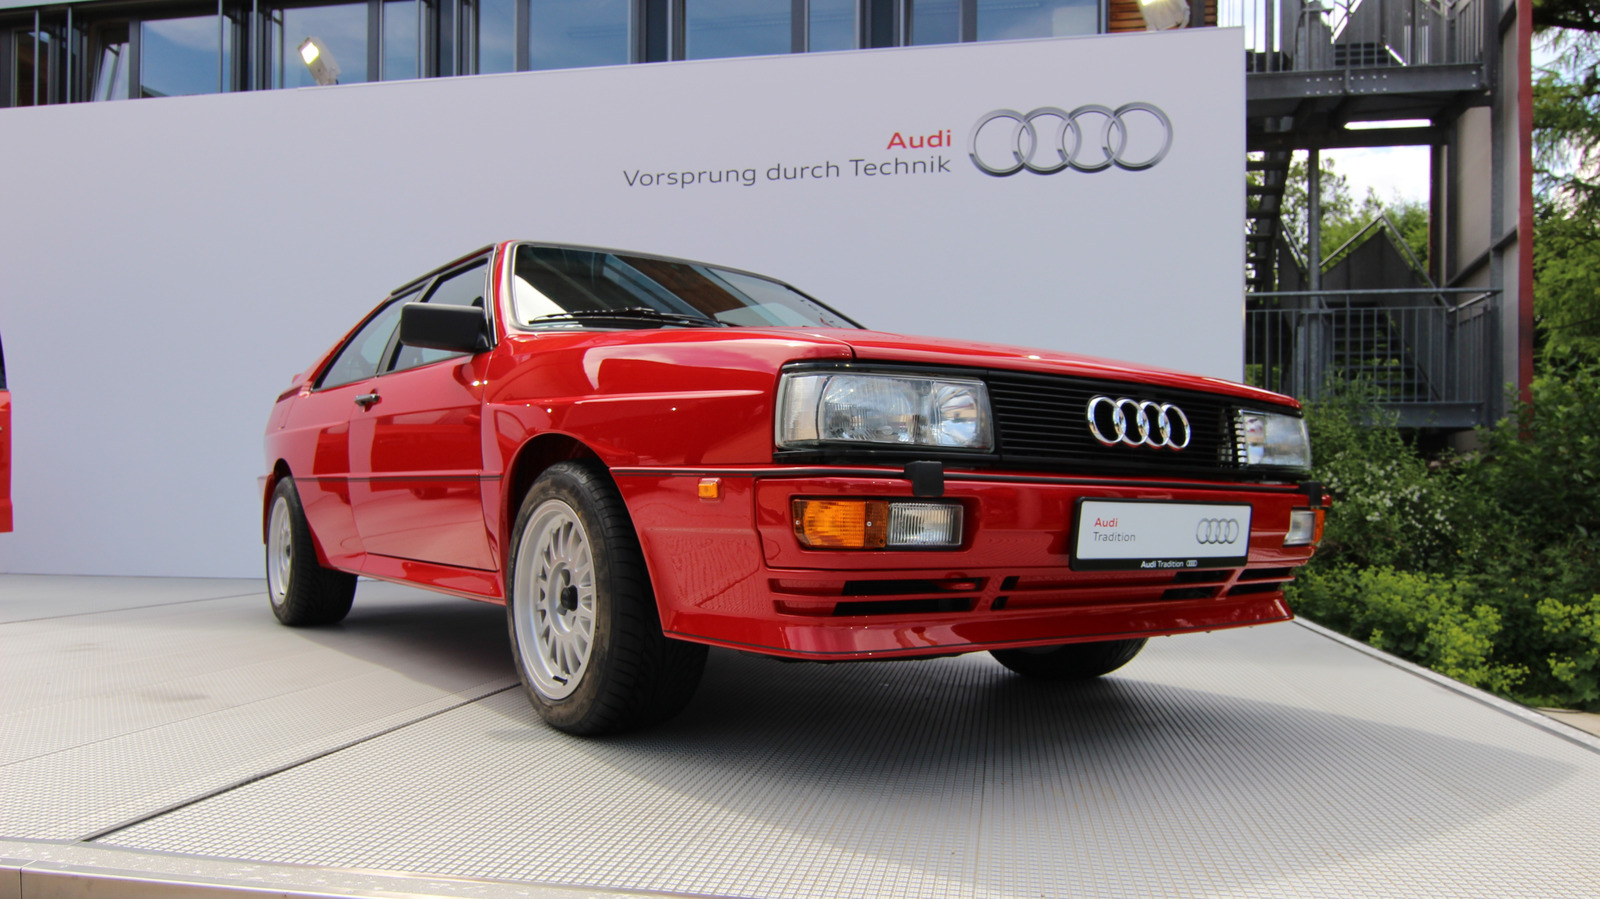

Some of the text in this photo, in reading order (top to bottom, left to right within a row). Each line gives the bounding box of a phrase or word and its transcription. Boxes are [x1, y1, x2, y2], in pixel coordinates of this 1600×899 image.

[886, 129, 952, 150] Audi
[623, 155, 952, 189] Vorsprung durch Technik
[1094, 517, 1118, 527] Audi
[1093, 531, 1136, 542] Tradition
[1140, 560, 1184, 568] Audi Tradition
